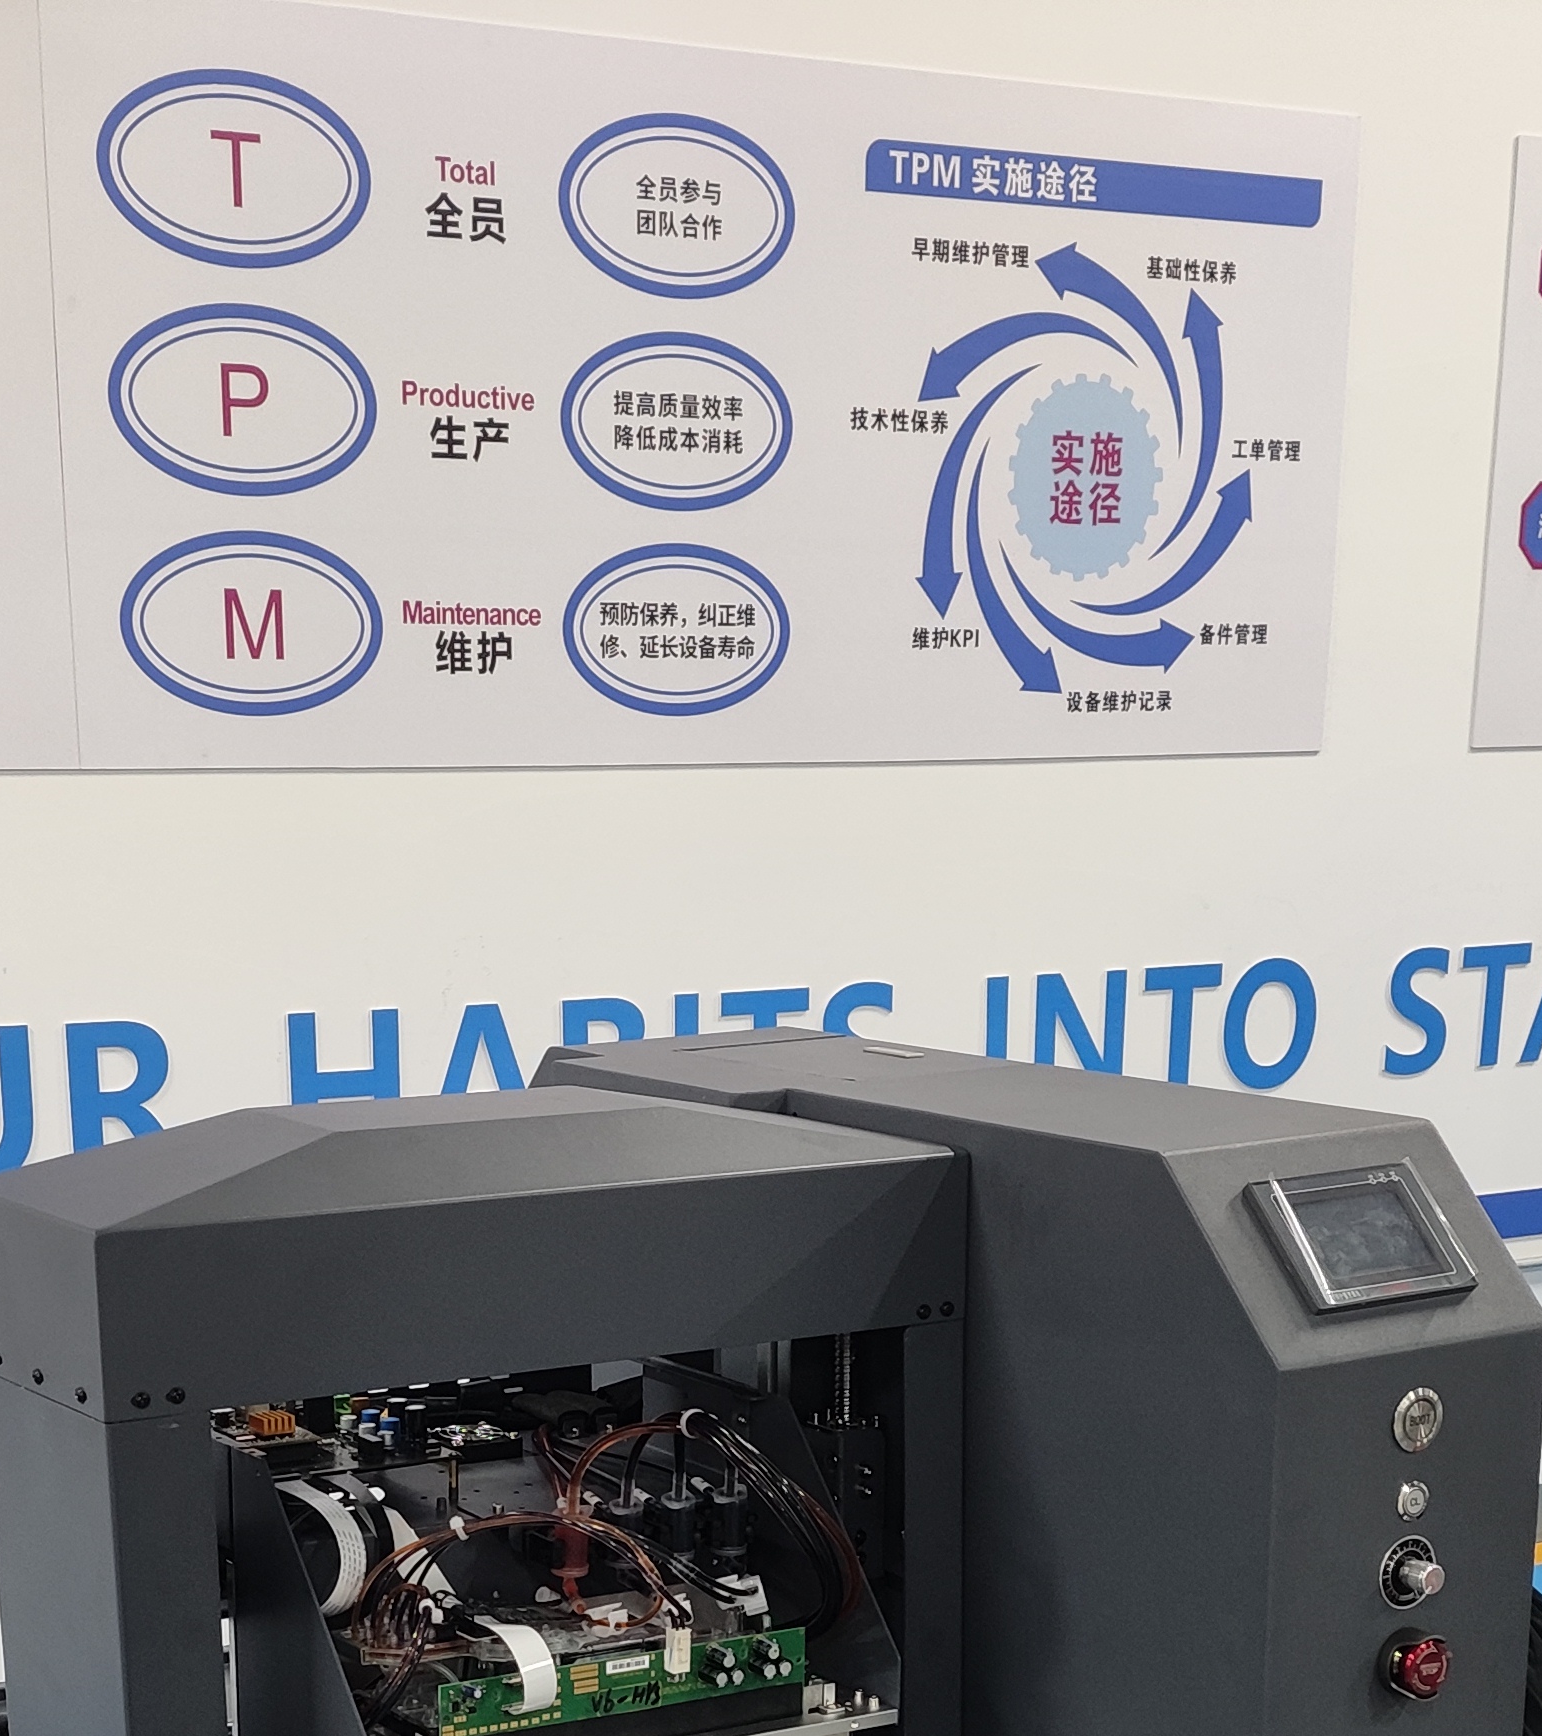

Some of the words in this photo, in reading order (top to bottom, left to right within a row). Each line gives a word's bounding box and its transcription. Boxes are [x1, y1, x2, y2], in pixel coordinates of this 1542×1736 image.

[210, 129, 261, 208] T
[435, 156, 496, 187] Total
[890, 149, 961, 189] TPM
[971, 155, 1099, 203] 实施途径
[636, 175, 722, 206] 全员参与
[424, 193, 507, 244] 全员
[636, 210, 723, 241] 团队合作
[911, 237, 1030, 268] 早期维护管理
[1146, 256, 1238, 284] 基础性保养
[220, 363, 269, 437] P
[402, 381, 535, 411] Productive
[613, 390, 744, 421] 提高质量效率
[850, 408, 949, 435] 技术性保养
[429, 415, 509, 462] 生产
[613, 425, 744, 455] 降低成本消耗
[1051, 431, 1124, 477] 实施
[1232, 439, 1302, 463] 工单管理
[1049, 482, 1122, 526] 途径
[224, 587, 285, 660] M
[402, 601, 542, 627] Maintenance
[599, 602, 756, 628] 预防保养，纠正维
[600, 634, 755, 660] 修、延长设备寿命
[911, 627, 980, 650] 维护KPI
[1199, 624, 1269, 647] 备件管理
[435, 631, 514, 675] 维护
[1066, 691, 1173, 713] 设备维护记录
[985, 957, 1317, 1090] INTO
